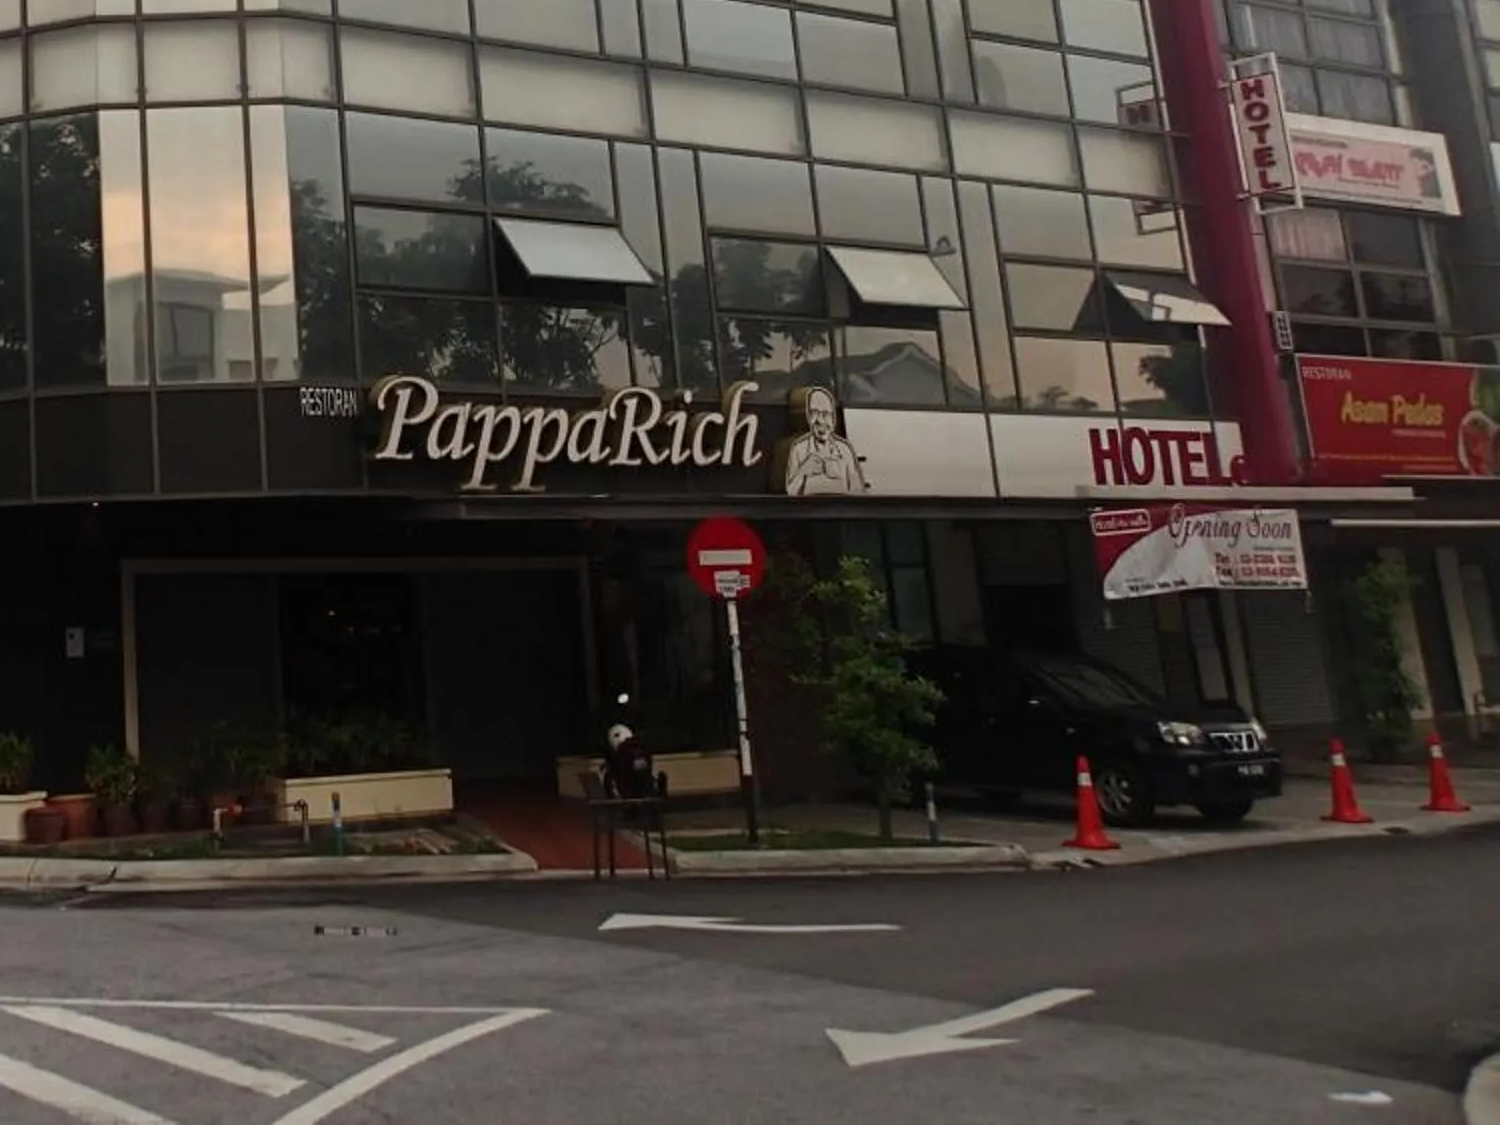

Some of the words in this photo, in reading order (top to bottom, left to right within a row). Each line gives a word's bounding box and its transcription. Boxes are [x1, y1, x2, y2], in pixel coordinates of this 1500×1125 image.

[1240, 78, 1281, 190] HOTEL
[300, 386, 358, 417] RESTORAN
[375, 375, 762, 491] PappaRich
[1088, 427, 1231, 486] HOTEL
[1167, 502, 1242, 549] Opening
[1245, 507, 1292, 539] Soon
